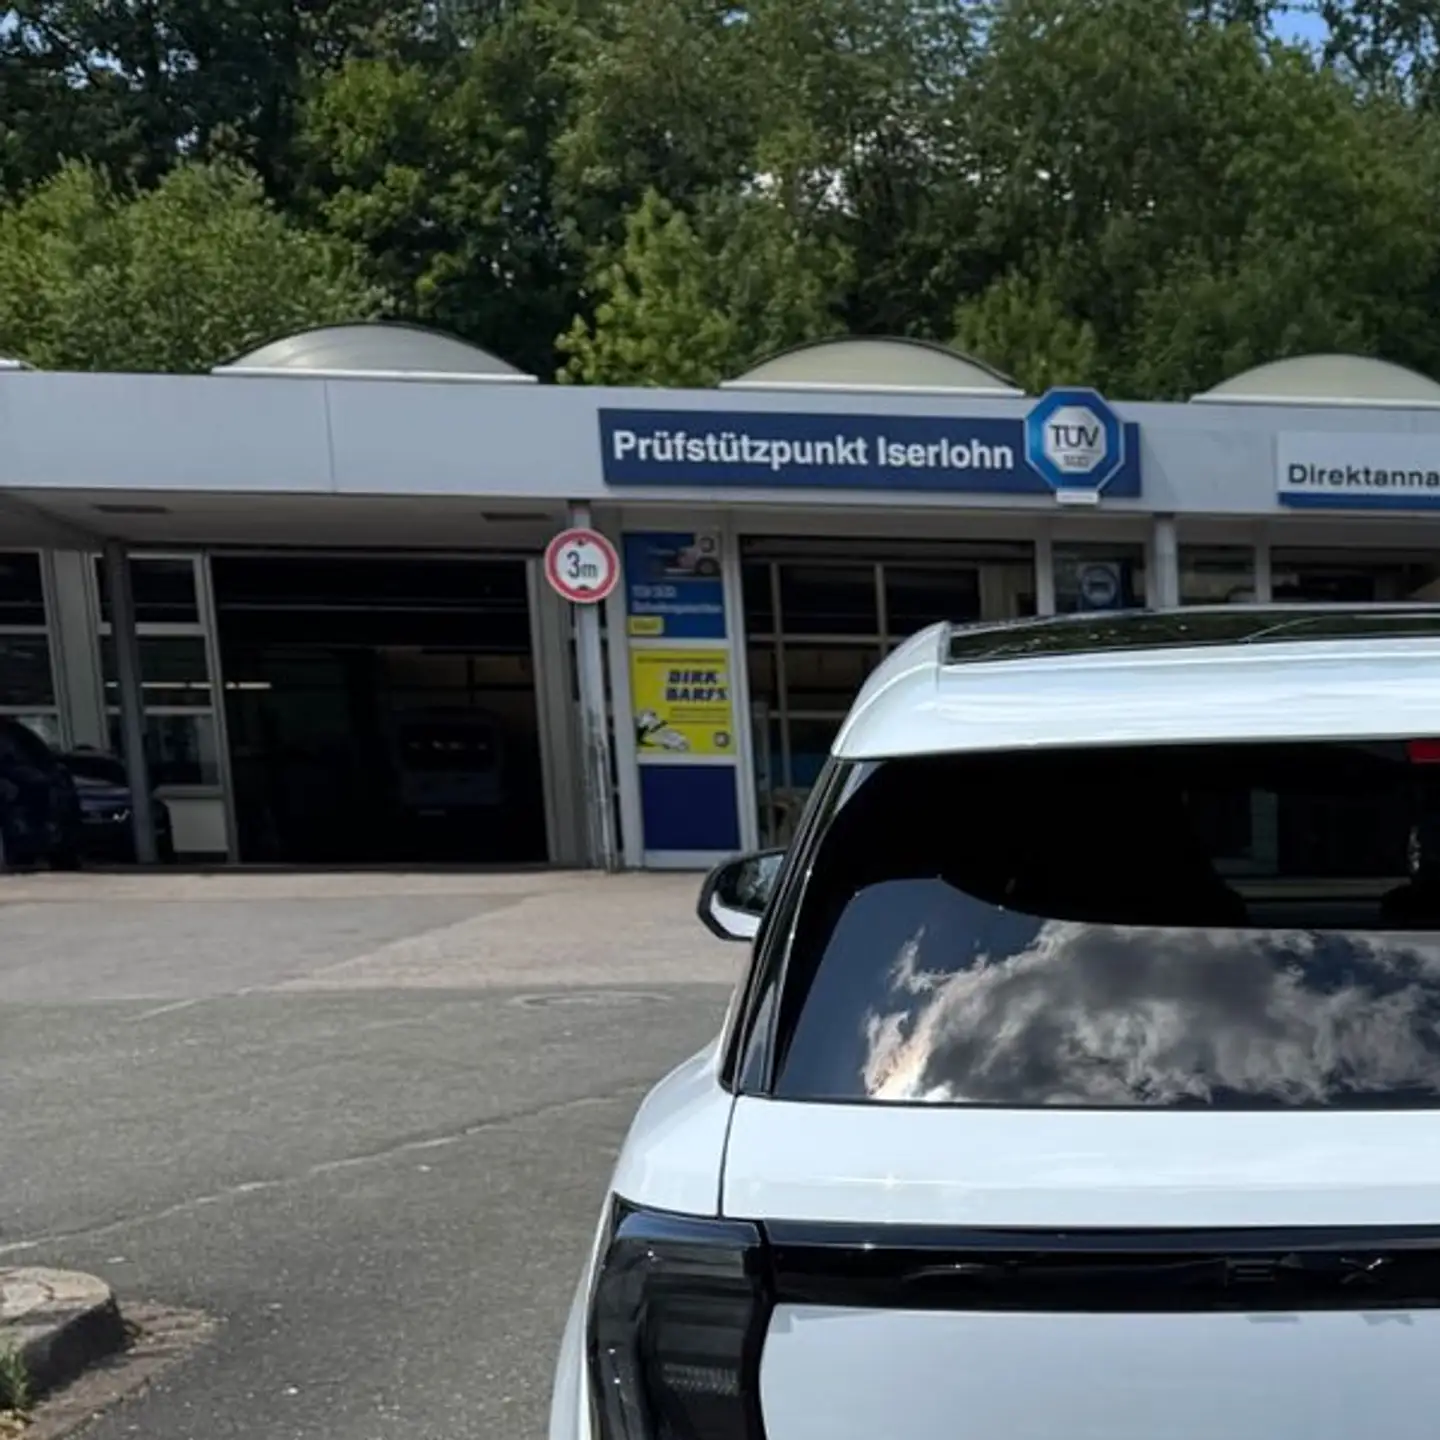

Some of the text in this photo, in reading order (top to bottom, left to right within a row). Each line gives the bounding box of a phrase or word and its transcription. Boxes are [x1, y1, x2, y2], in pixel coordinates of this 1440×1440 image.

[612, 429, 1015, 471] Prüfstützpunkt Iserlohn
[1049, 424, 1099, 448] TÜV
